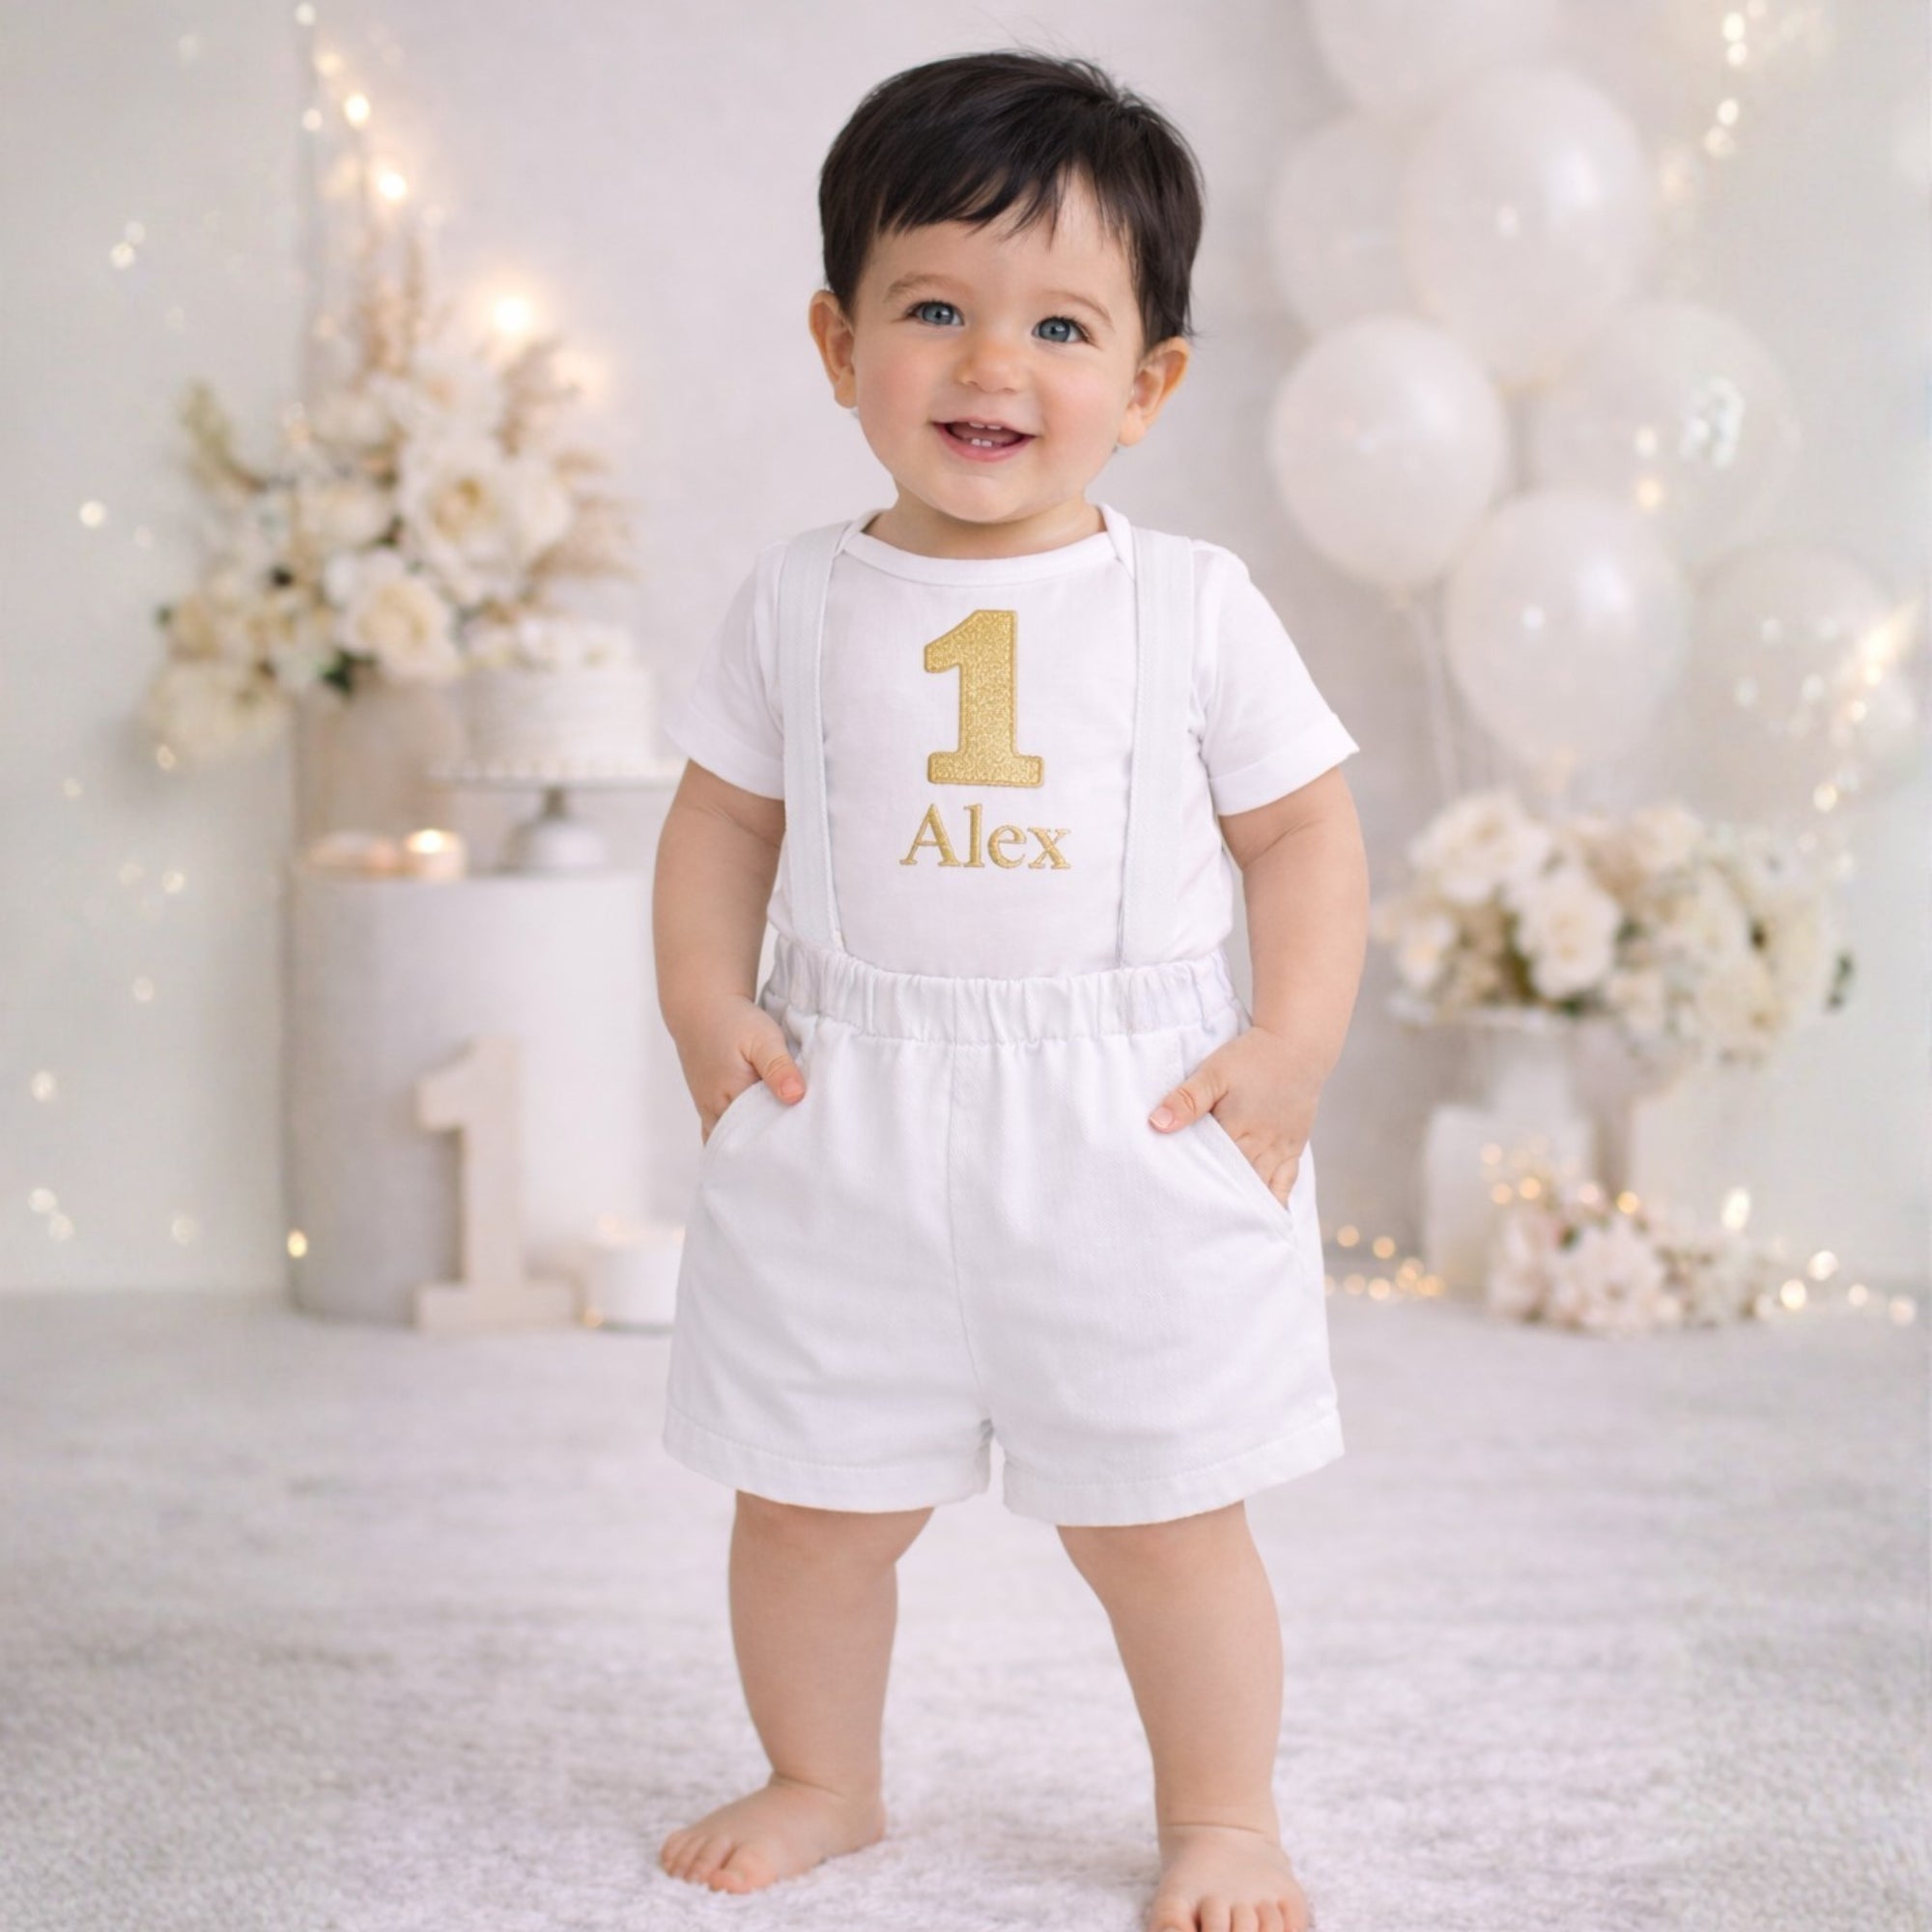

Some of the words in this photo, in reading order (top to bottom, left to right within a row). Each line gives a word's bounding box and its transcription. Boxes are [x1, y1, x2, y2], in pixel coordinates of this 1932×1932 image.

[923, 610, 1044, 788] 1
[899, 803, 1071, 869] Alex
[413, 1037, 578, 1332] 1
